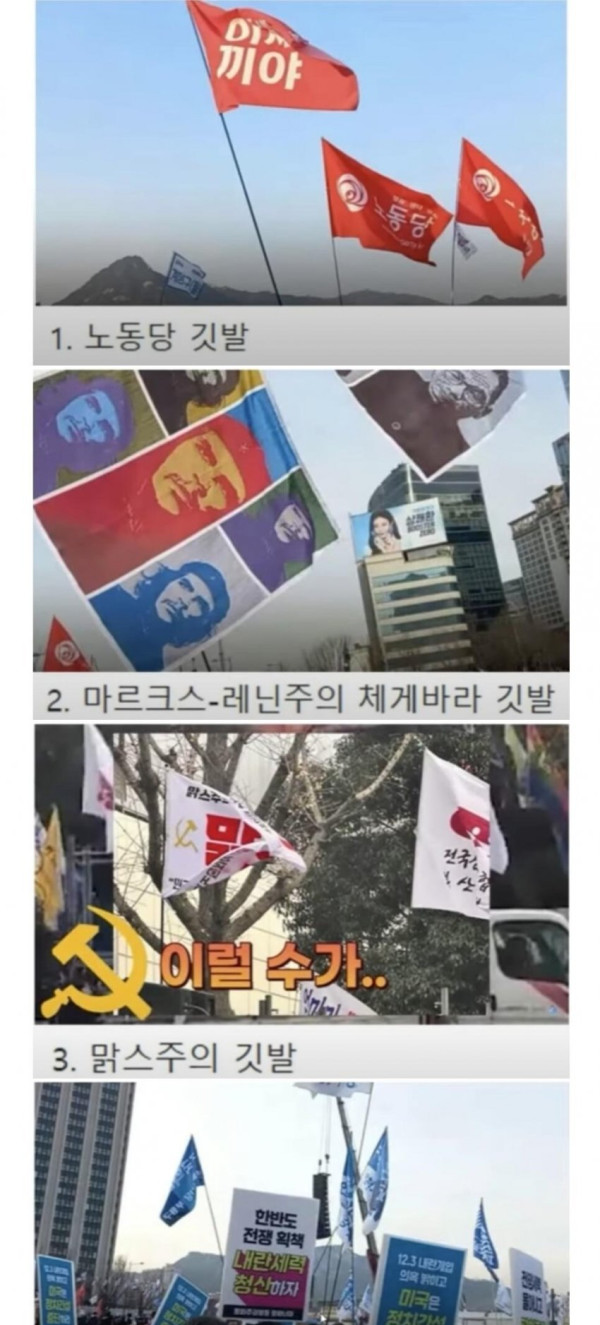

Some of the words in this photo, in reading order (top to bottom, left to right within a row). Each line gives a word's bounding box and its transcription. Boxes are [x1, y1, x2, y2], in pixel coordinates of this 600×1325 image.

[373, 197, 437, 238] 노동당
[254, 1208, 298, 1229] 한반도
[243, 1227, 273, 1246] 전쟁
[276, 1231, 305, 1249] 획책
[232, 1249, 308, 1275] 내란세력
[397, 1253, 418, 1267] 12.3
[418, 1257, 455, 1274] 내란계엄
[233, 1273, 299, 1297] 청산하자
[399, 1269, 420, 1283] 의혹
[420, 1272, 448, 1288] 밝히고
[398, 1288, 441, 1311] 미국은
